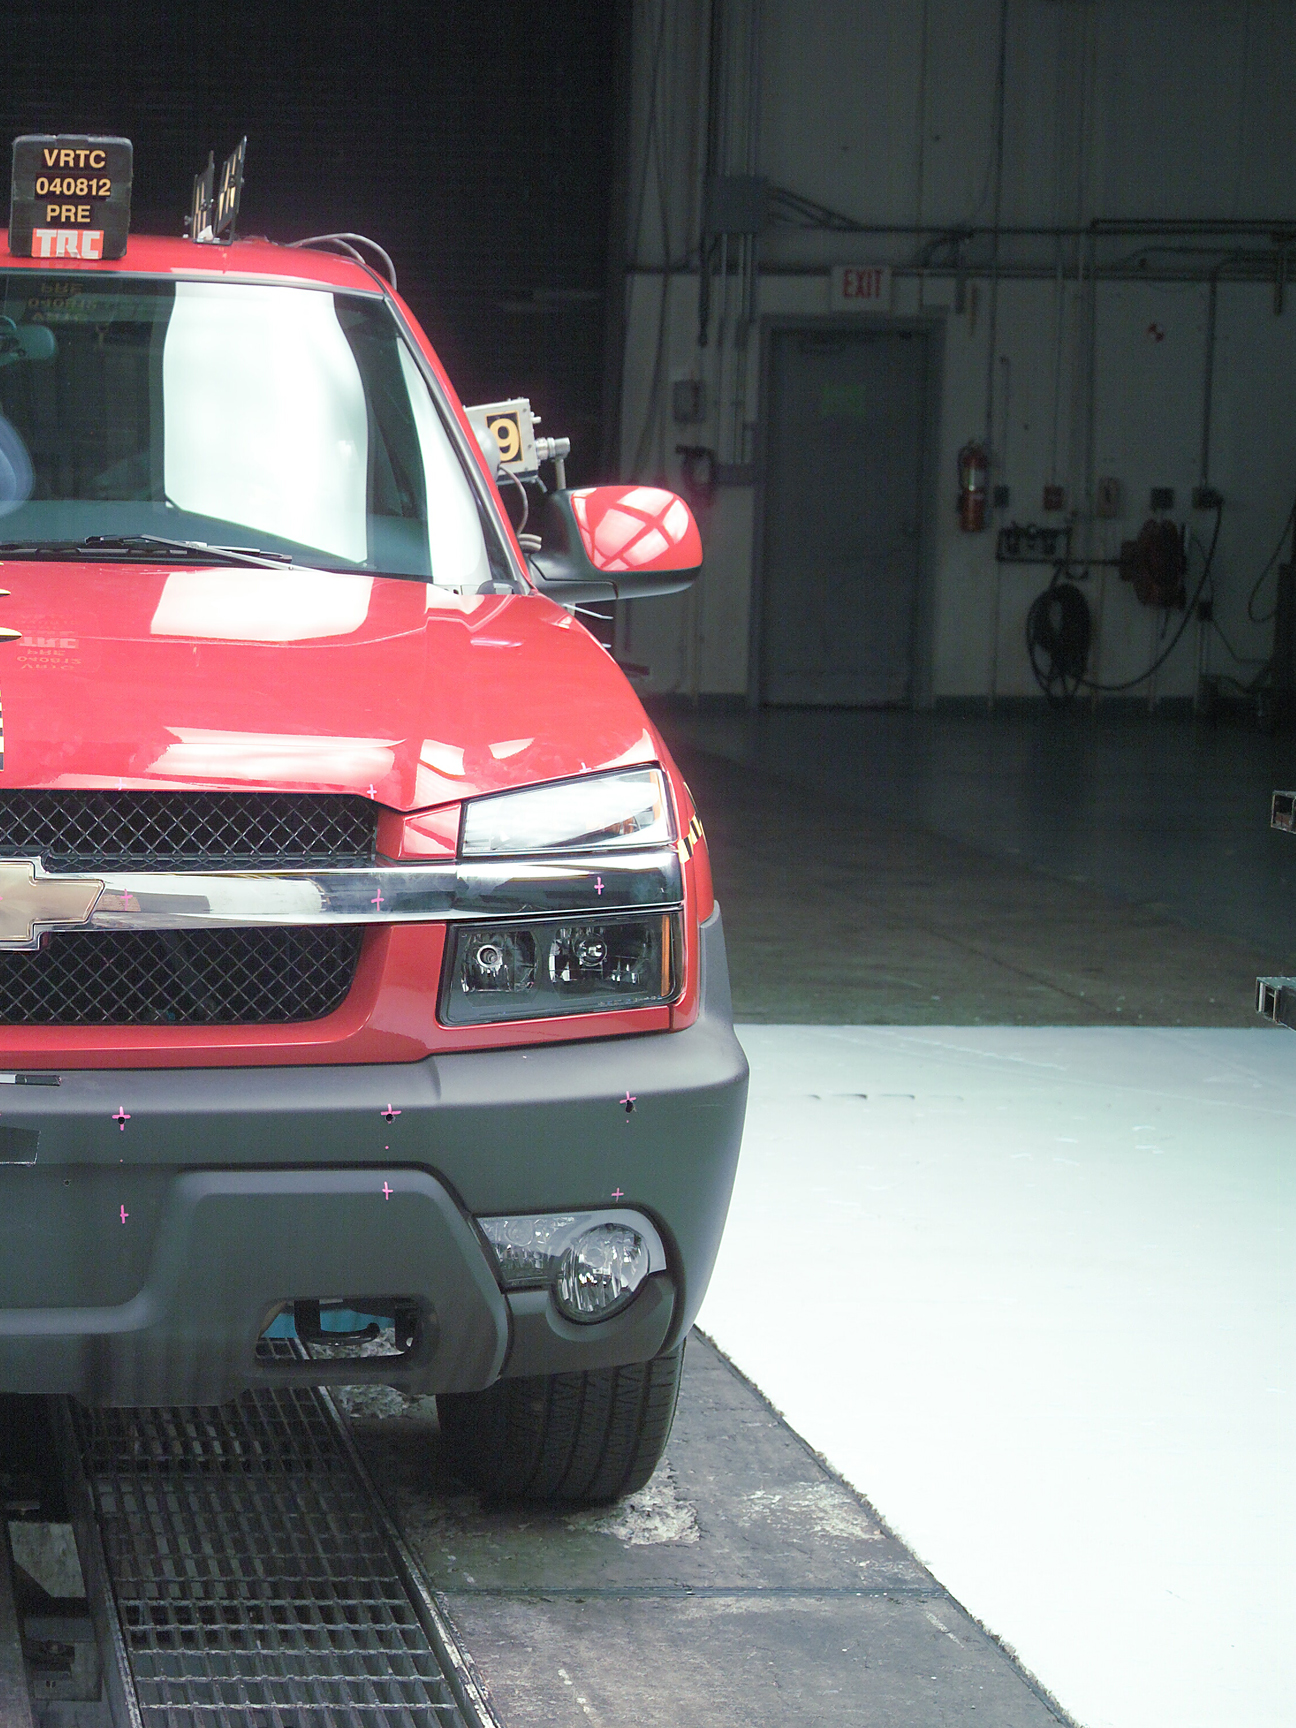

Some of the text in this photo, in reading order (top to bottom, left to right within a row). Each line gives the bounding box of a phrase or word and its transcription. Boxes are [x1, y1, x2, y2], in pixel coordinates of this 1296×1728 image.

[43, 148, 106, 169] VRTC
[35, 177, 111, 196] 040812
[46, 204, 91, 223] PRE
[36, 229, 100, 259] TRC
[843, 269, 882, 298] EXIT
[489, 418, 520, 461] 9
